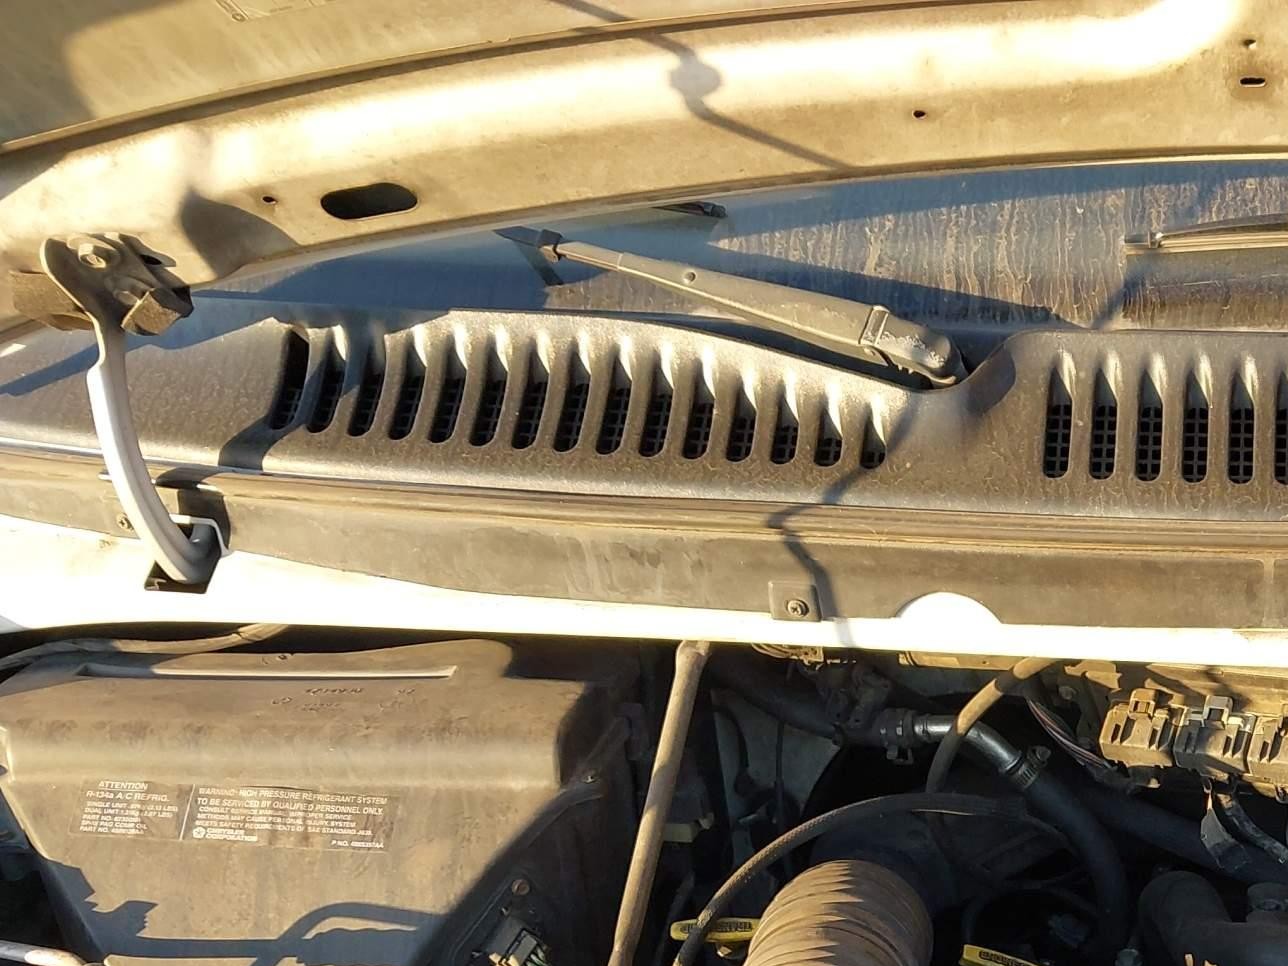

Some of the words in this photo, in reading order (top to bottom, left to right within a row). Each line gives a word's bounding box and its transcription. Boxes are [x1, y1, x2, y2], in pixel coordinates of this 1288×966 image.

[98, 781, 148, 790] ATTENTION
[259, 790, 301, 799] PRESSURE
[302, 793, 356, 803] REFRIGERANT
[273, 801, 314, 811] QUALIFIED
[315, 804, 361, 814] PERSONNEL
